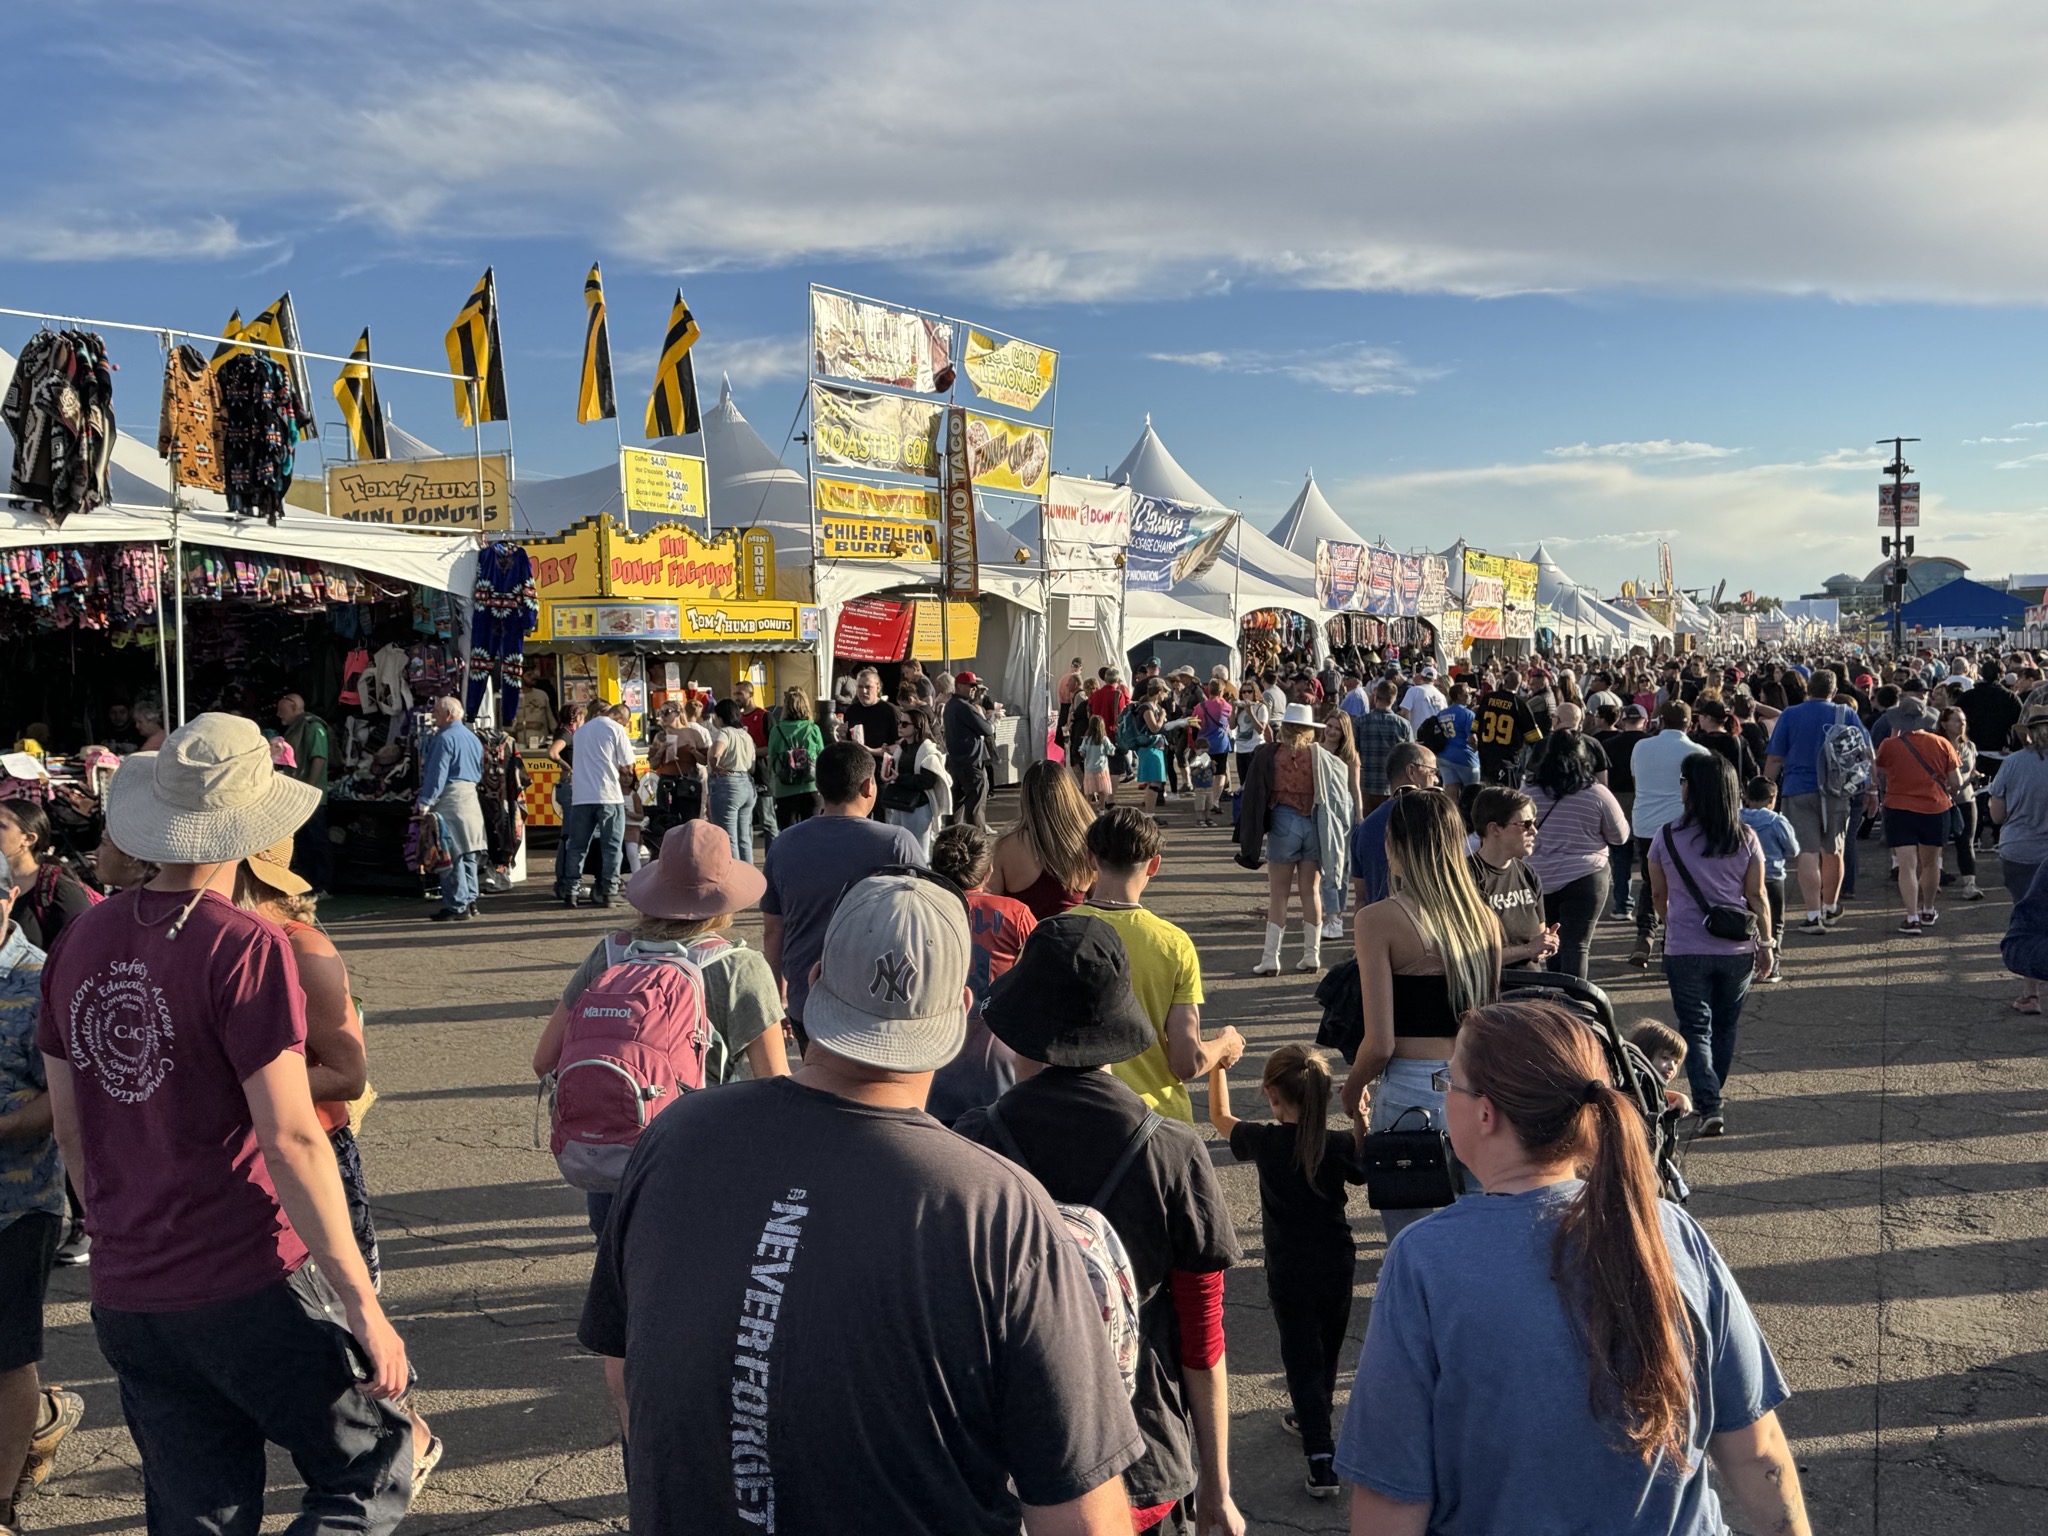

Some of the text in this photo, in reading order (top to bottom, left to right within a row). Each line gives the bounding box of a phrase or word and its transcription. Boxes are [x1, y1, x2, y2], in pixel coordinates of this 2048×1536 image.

[979, 361, 1041, 397] LEMONADE
[816, 424, 900, 464] ROASTED
[651, 456, 667, 467] $4.00
[666, 470, 682, 480] $4.00
[672, 481, 688, 492] $4.00
[667, 491, 683, 501] $4.00
[950, 414, 973, 592] NAVAJO TACO
[402, 504, 498, 524] DONUTS
[681, 504, 697, 513] $4.00
[659, 535, 688, 558] MINI
[747, 535, 770, 544] MINI
[834, 541, 924, 555] BURRO
[611, 555, 733, 588] DONUT FACTORY
[753, 545, 766, 596] DONUT
[757, 619, 792, 632] DONUTS
[1488, 697, 1513, 710] PARKER
[1481, 711, 1515, 745] 39
[527, 762, 553, 770] YOUR
[868, 949, 918, 1004] NY
[109, 958, 148, 980] Safety
[151, 985, 175, 1041] Access
[582, 1005, 632, 1019] Marmot
[114, 1025, 145, 1041] CAC
[730, 1200, 809, 1535] NEVER FORGET
